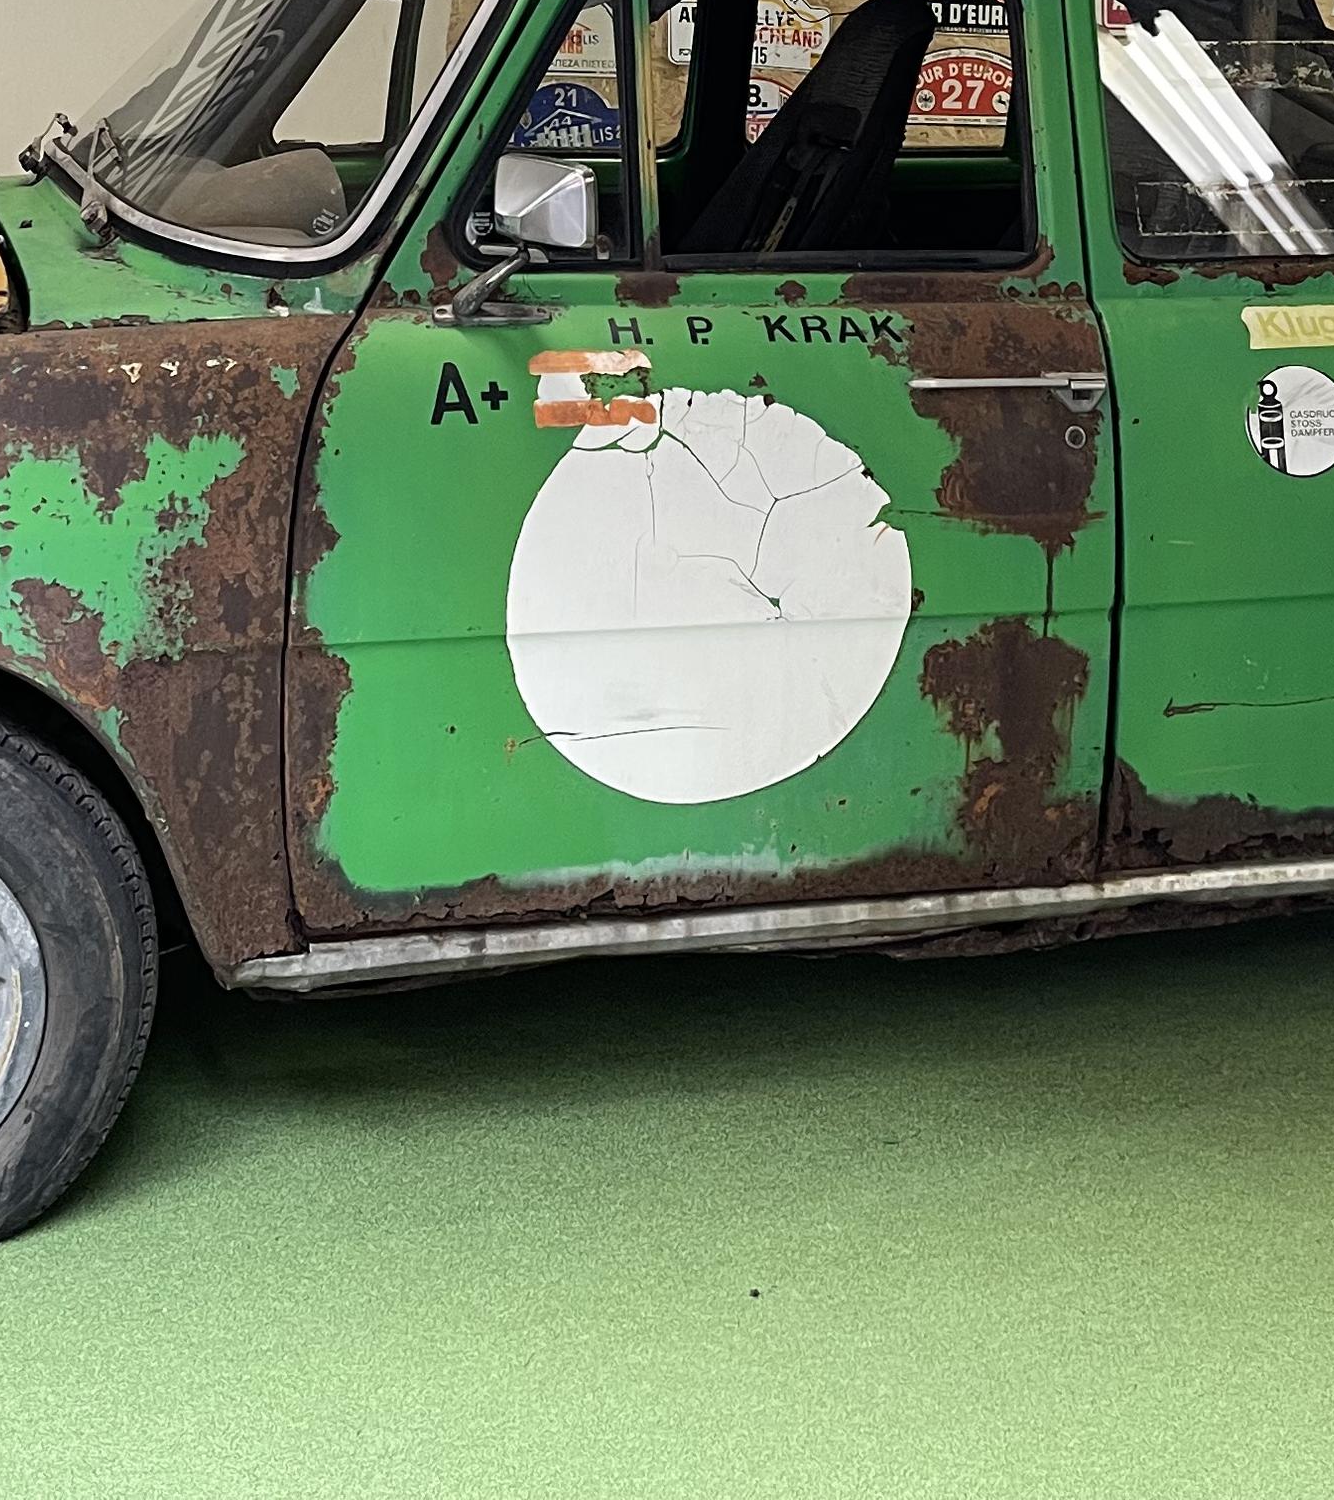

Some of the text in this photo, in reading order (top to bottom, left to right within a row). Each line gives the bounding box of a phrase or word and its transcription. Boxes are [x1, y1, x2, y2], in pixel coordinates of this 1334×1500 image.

[555, 88, 576, 107] 21
[941, 79, 985, 110] 27
[607, 315, 904, 346] H. P. KRAK
[430, 362, 508, 425] A+
